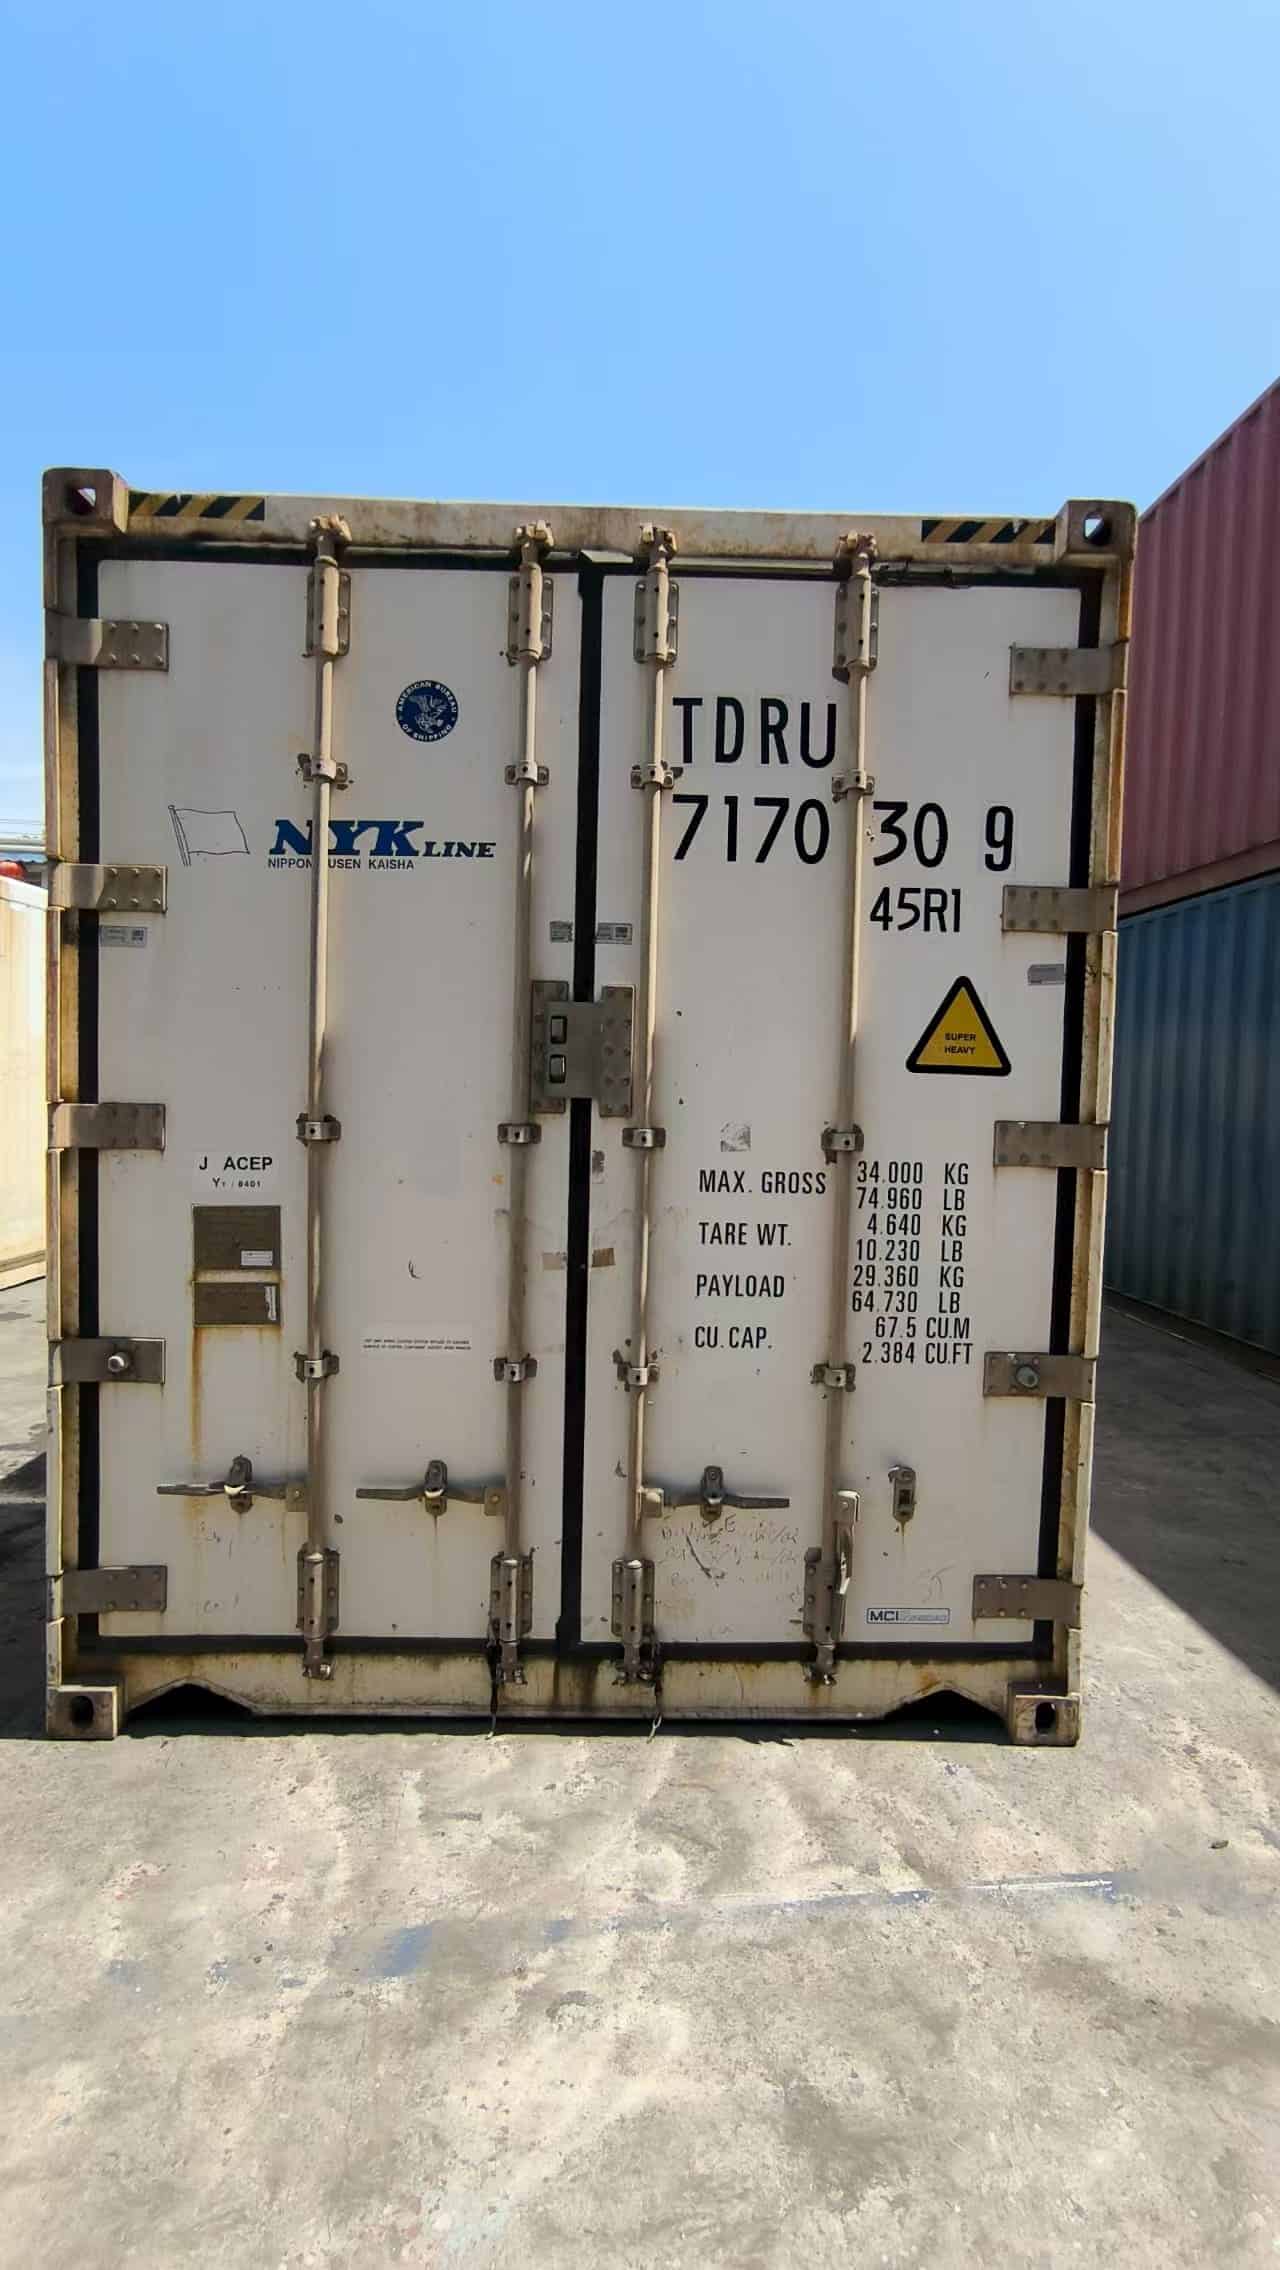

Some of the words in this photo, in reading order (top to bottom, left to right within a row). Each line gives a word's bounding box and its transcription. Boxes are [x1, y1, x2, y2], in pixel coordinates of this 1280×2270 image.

[671, 696, 836, 768] TDRU
[269, 819, 424, 857] NYK
[422, 841, 496, 858] LINE
[985, 806, 1013, 871] 9
[268, 858, 313, 869] NIPPON
[328, 858, 361, 869] USEN
[369, 859, 414, 869] KAISHA
[870, 887, 960, 932] 45R1
[945, 1033, 976, 1041] SUPER
[945, 1046, 975, 1054] HEAVY
[199, 1156, 207, 1170] J
[224, 1156, 272, 1170] ACEP
[700, 1170, 752, 1192] MAX.
[762, 1172, 826, 1194] GROSS
[857, 1161, 923, 1183] 34.000
[945, 1163, 968, 1184] KG
[856, 1187, 922, 1209] 74.960
[944, 1189, 965, 1211] LB
[699, 1222, 748, 1245] TARE
[757, 1224, 791, 1246] WT.
[867, 1213, 920, 1235] 4.640
[942, 1215, 966, 1236] KG
[857, 1239, 919, 1261] 10.230
[941, 1240, 962, 1262] LB
[696, 1274, 784, 1297] PAYLOAD
[853, 1265, 918, 1287] 29.360
[940, 1266, 964, 1288] KG
[852, 1290, 917, 1312] 64.730
[939, 1292, 960, 1313] LB
[876, 1316, 916, 1338] 67.5
[926, 1317, 970, 1339] CU.M
[862, 1342, 914, 1363] 2.384
[925, 1343, 973, 1364] CU.FT
[870, 1611, 898, 1621] MCI
